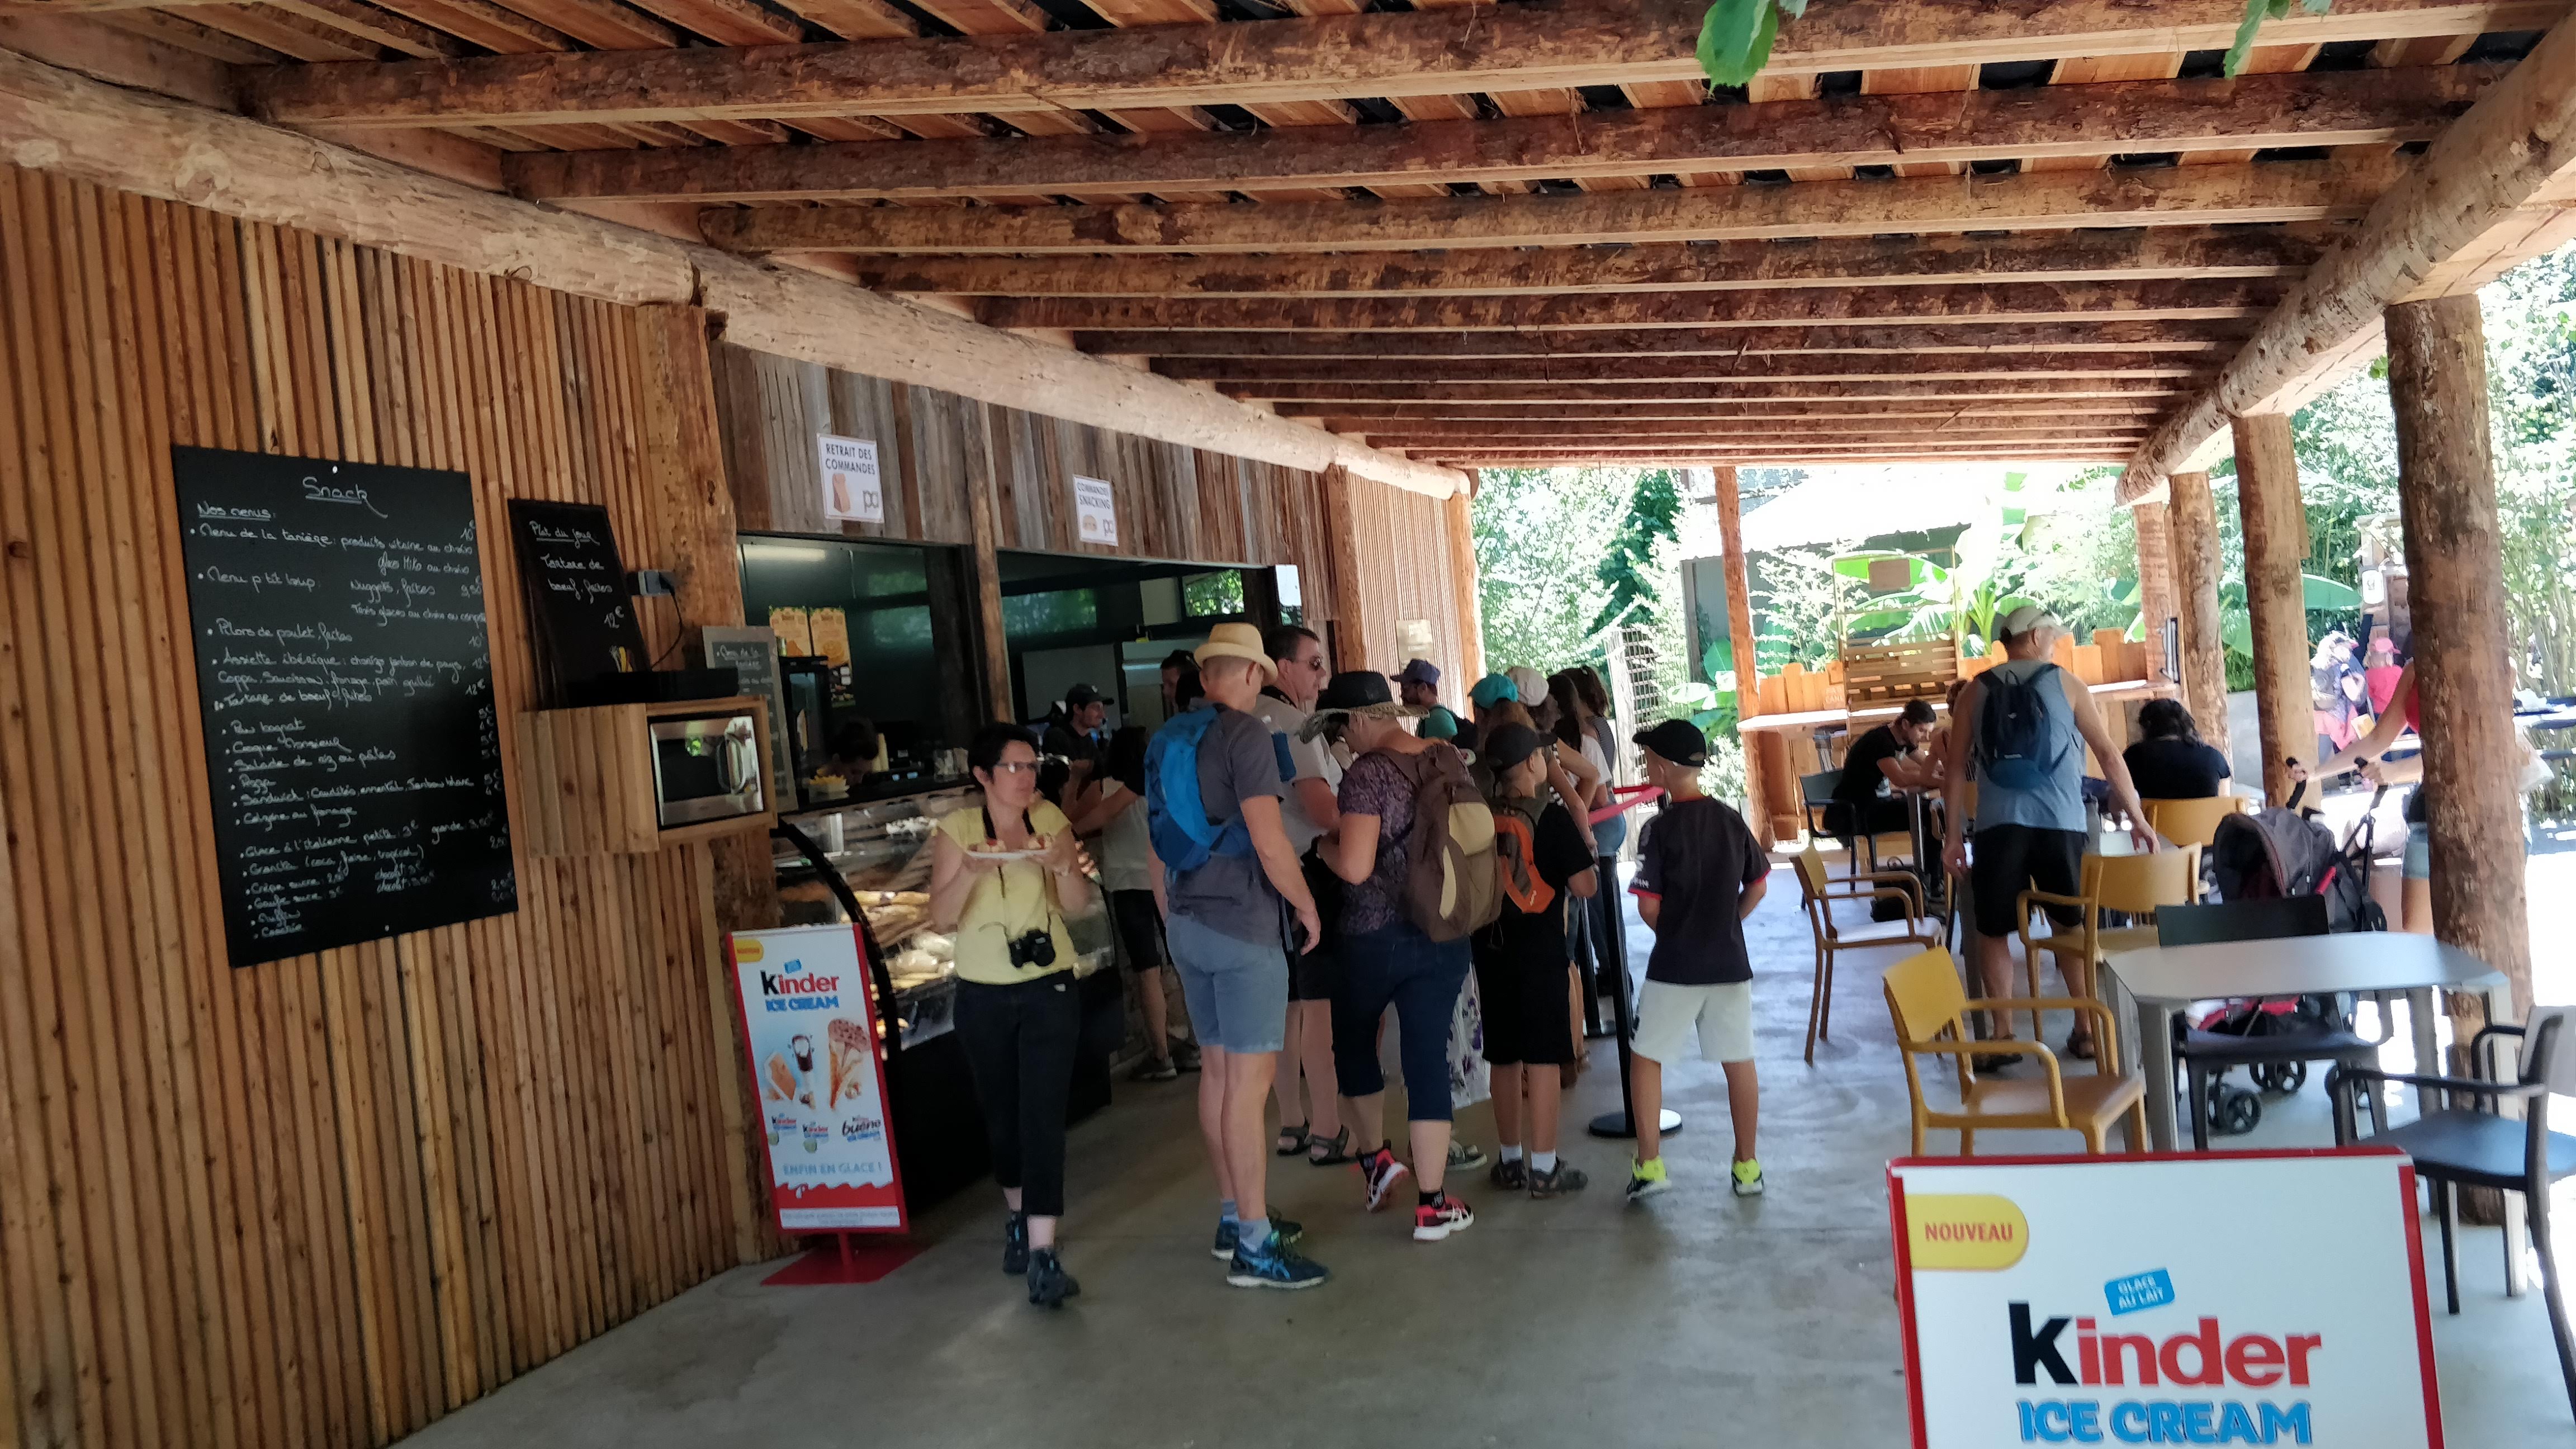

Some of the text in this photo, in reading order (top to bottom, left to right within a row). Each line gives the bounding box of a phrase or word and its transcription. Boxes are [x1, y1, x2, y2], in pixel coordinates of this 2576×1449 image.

[826, 443, 872, 460] RETRAIT DES
[825, 458, 875, 475] COMMANDES
[302, 476, 389, 519] Snack
[200, 522, 237, 537] Menu
[239, 527, 259, 538] de
[261, 528, 277, 540] la
[427, 544, 442, 553] au
[529, 520, 601, 550] Plat du jour
[427, 564, 442, 572] au
[540, 553, 605, 570] Tartare de
[207, 566, 248, 583] Menu
[257, 626, 274, 637] de
[419, 656, 434, 668] de
[278, 692, 297, 703] de
[292, 754, 314, 768] de
[291, 811, 308, 820] au
[820, 1163, 836, 1174] EN
[839, 1161, 874, 1173] GLACE
[1924, 1221, 2013, 1243] NOUVEAU
[2119, 1286, 2164, 1310] AU LAIT
[2016, 1399, 2313, 1446] ICE CREAM
